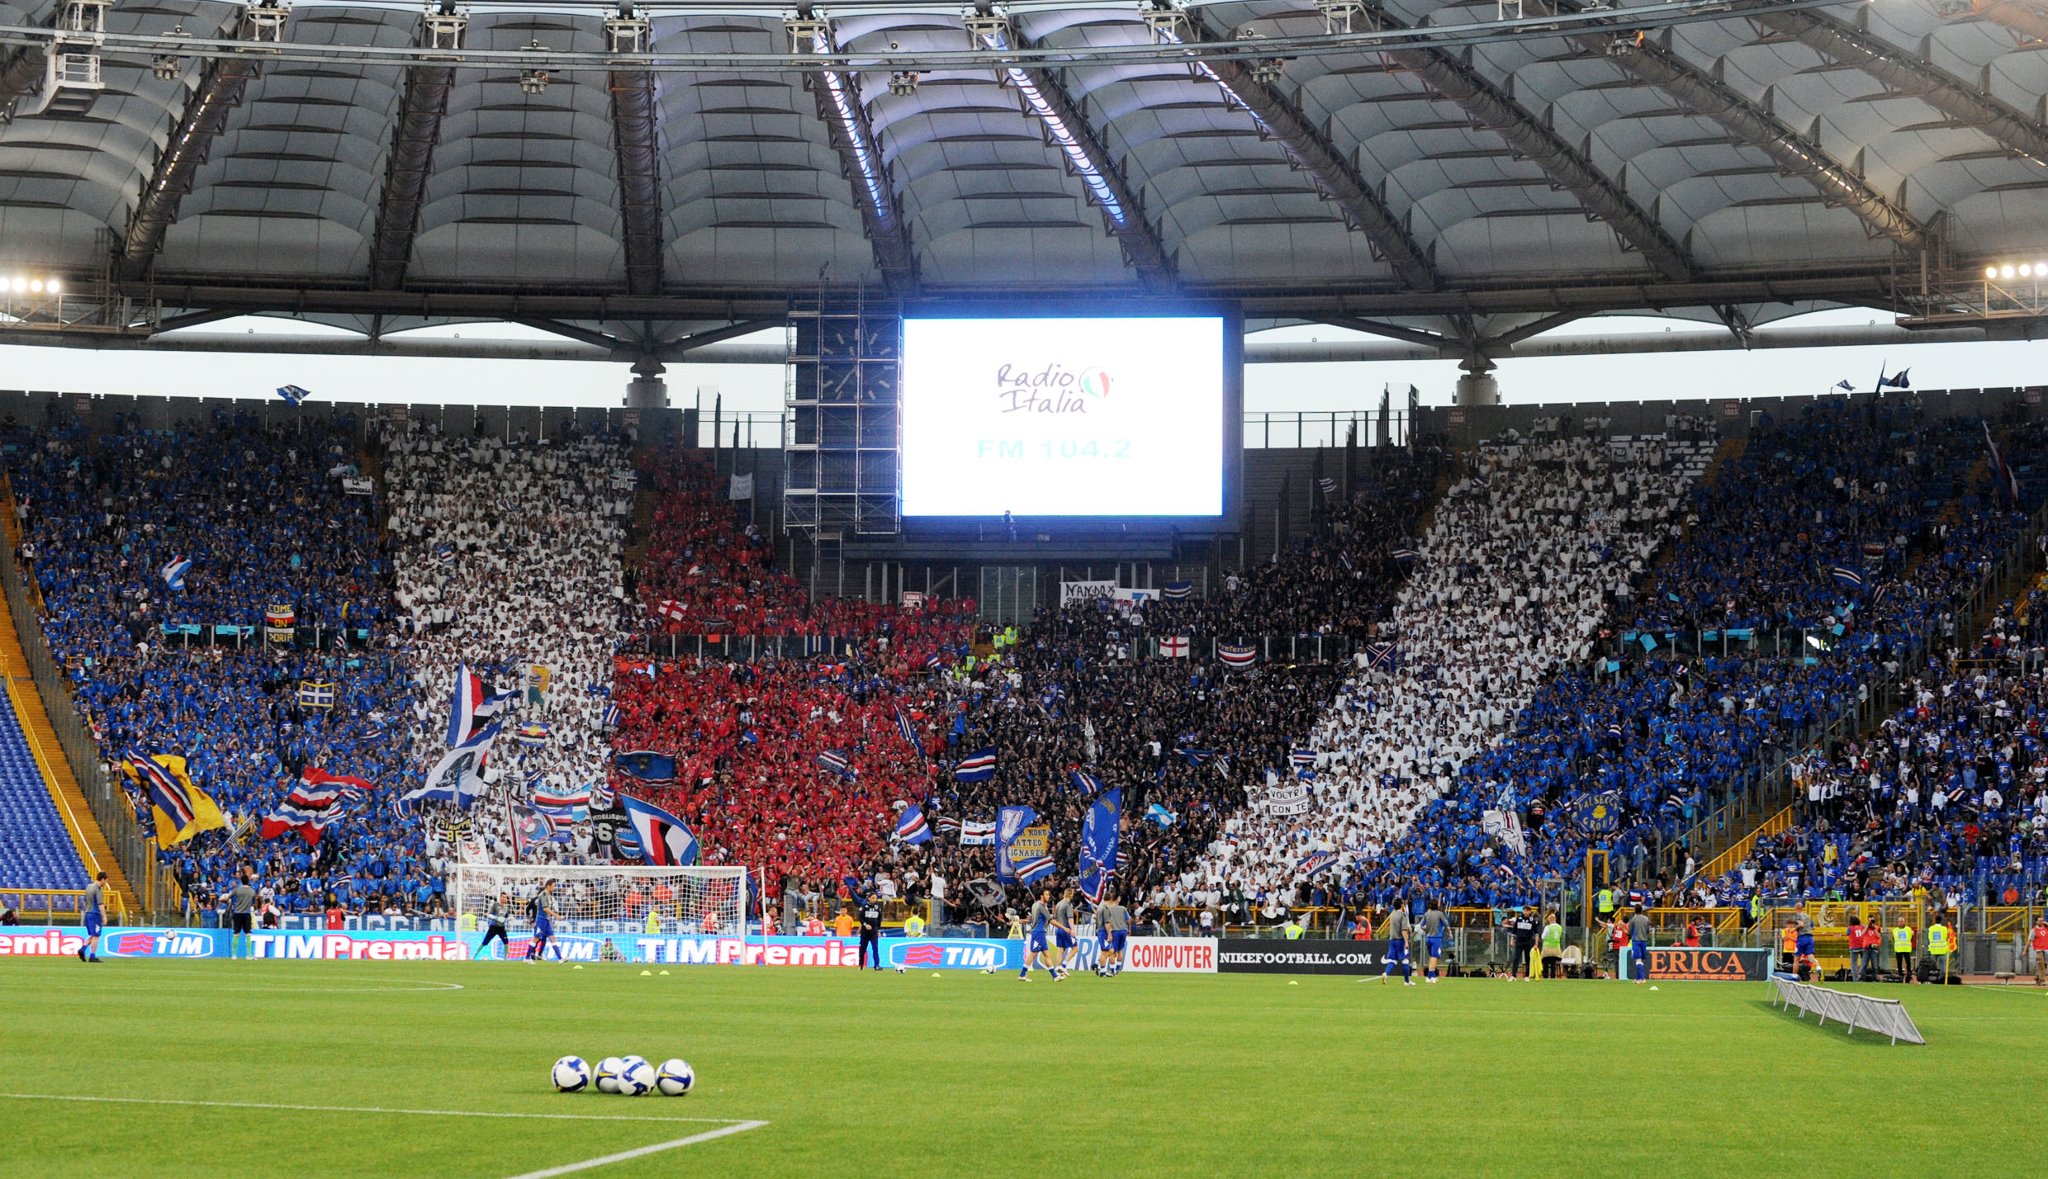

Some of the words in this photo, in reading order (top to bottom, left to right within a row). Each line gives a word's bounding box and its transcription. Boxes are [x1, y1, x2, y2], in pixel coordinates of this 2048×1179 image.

[997, 363, 1075, 387] Radio
[1000, 388, 1087, 413] Italia
[977, 439, 1025, 458] FM
[1040, 439, 1131, 458] 104.2
[268, 604, 293, 613] COME
[274, 619, 288, 628] ON
[1270, 788, 1303, 799] VOLTRI
[1271, 805, 1291, 813] CON
[1296, 801, 1307, 811] TE
[598, 822, 613, 841] 6
[1583, 816, 1615, 831] GROUP
[1013, 839, 1042, 847] ATTEO
[156, 935, 203, 954] TIM
[946, 947, 995, 966] TIM
[1131, 944, 1212, 968] COMPUTER
[1219, 952, 1372, 964] NIKEFOOTBALL.COM
[1649, 951, 1745, 973] ERICA
